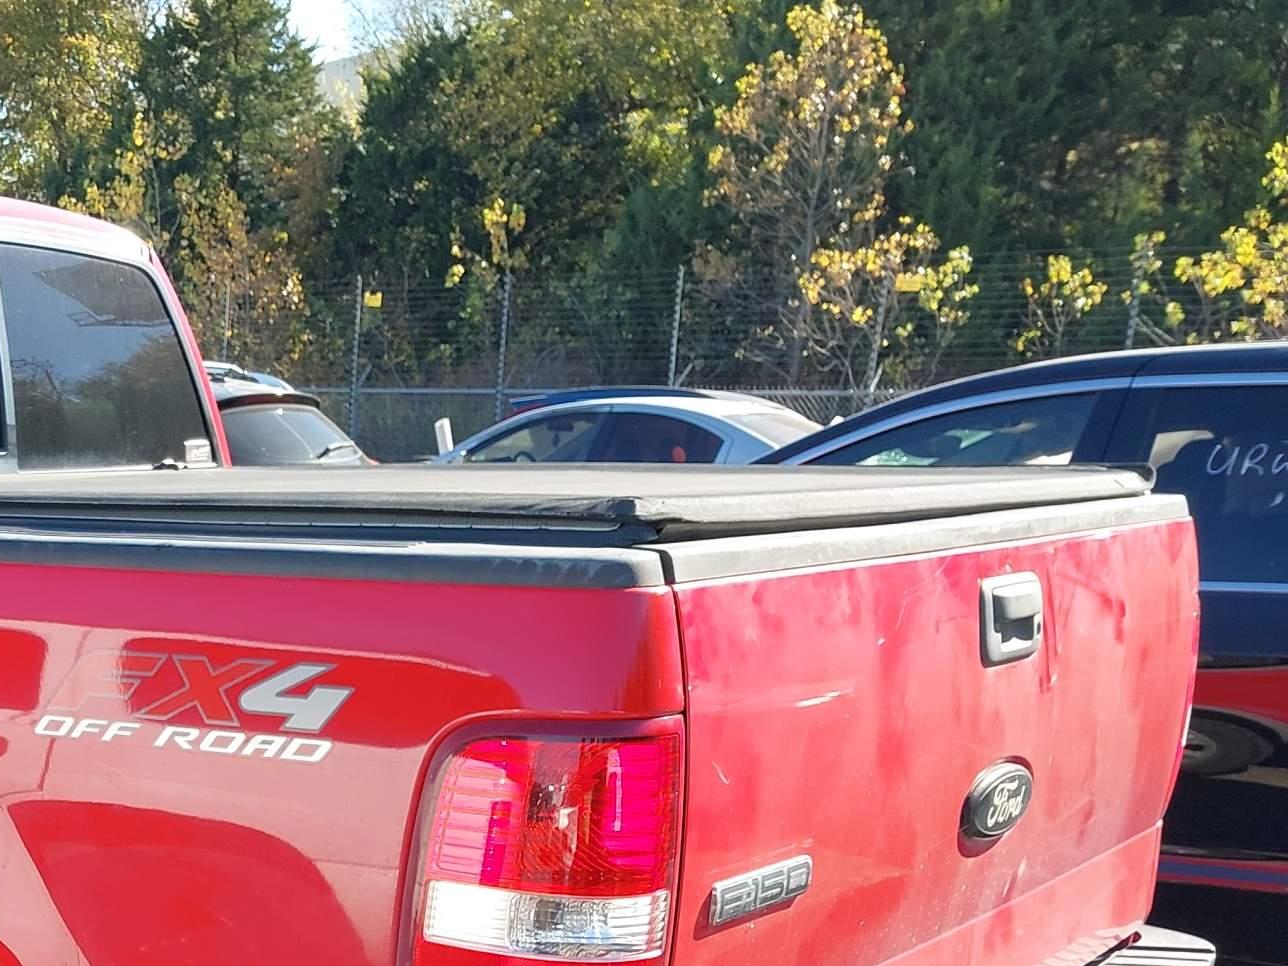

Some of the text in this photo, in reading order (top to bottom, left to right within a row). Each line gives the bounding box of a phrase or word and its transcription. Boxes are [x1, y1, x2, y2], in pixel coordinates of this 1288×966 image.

[45, 649, 356, 734] FX4
[34, 714, 334, 763] OFF ROAD
[987, 779, 1026, 828] Ford
